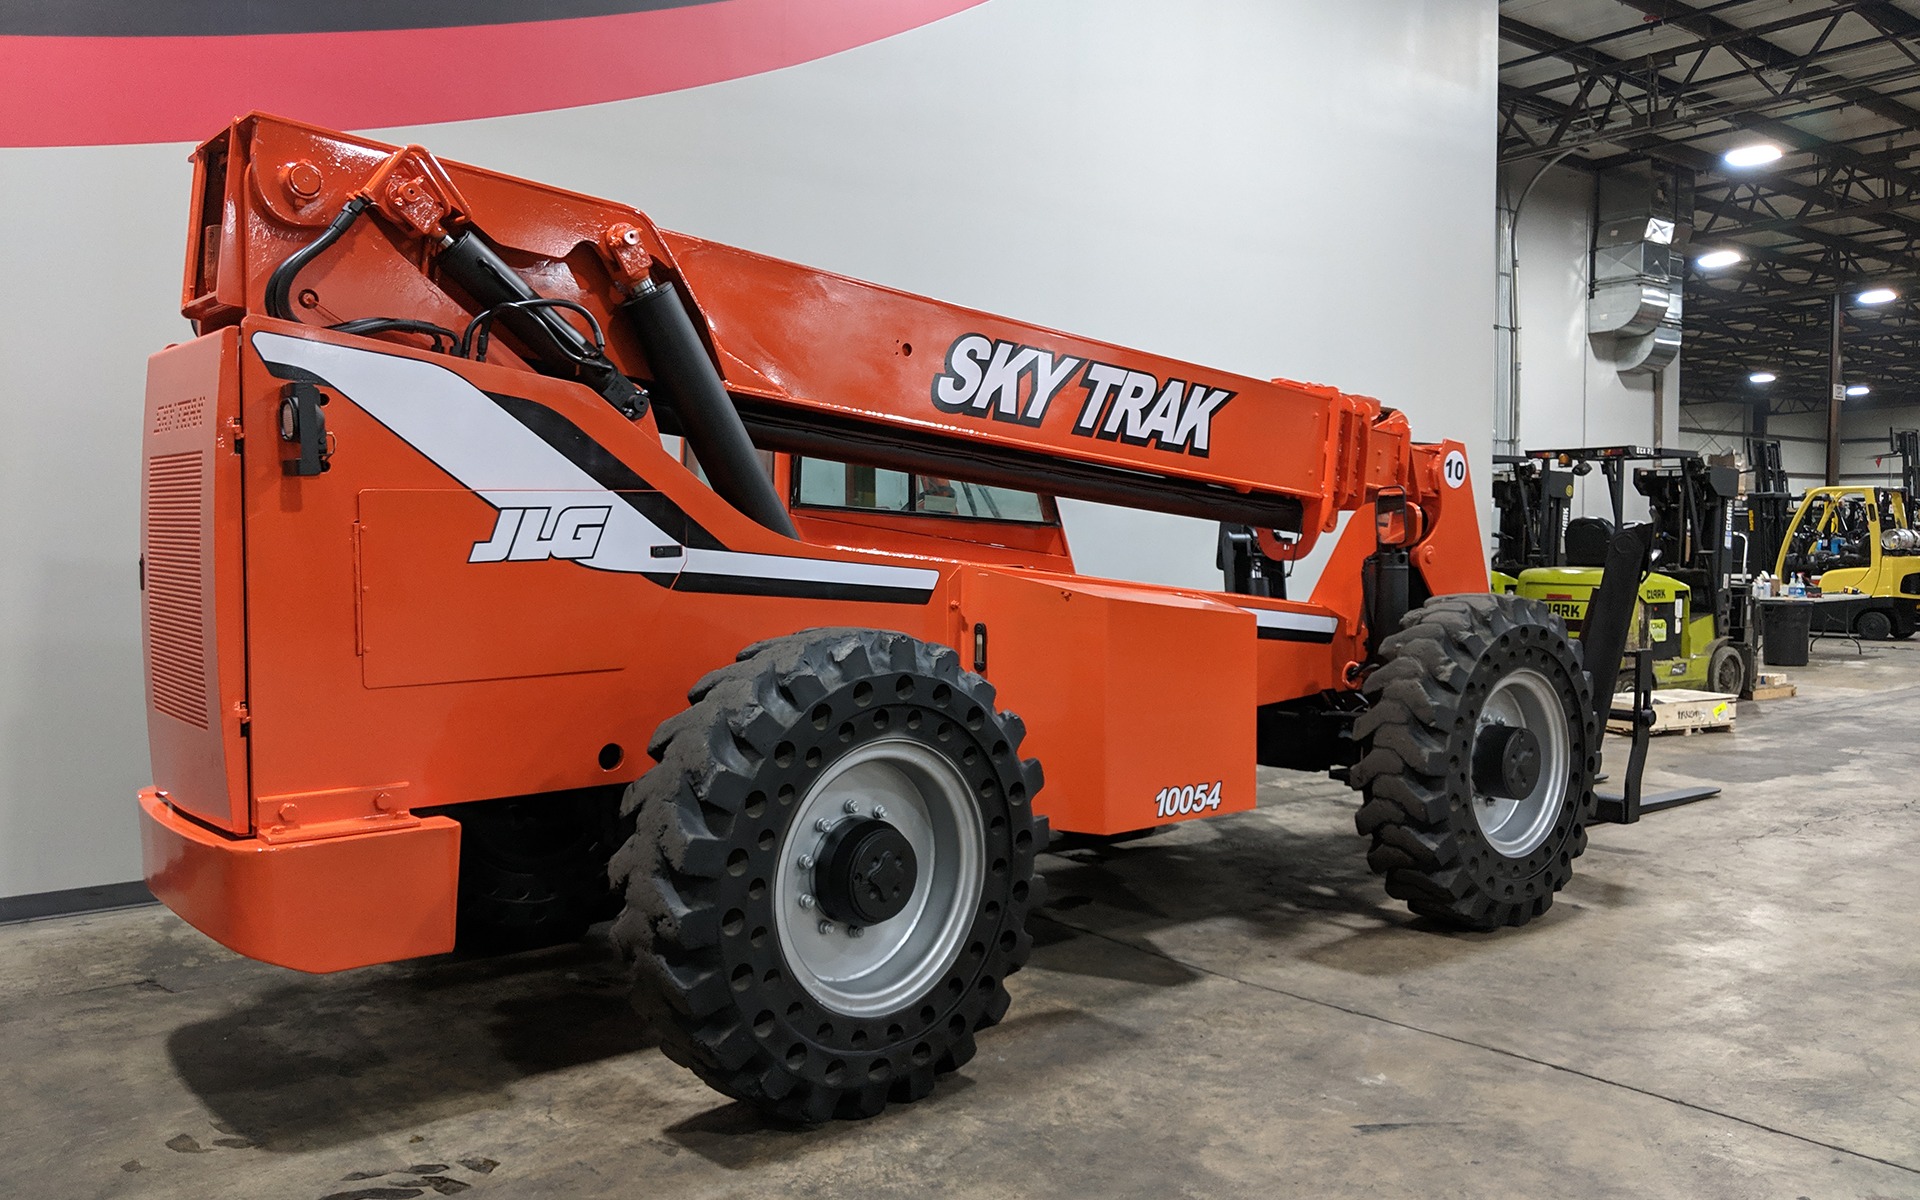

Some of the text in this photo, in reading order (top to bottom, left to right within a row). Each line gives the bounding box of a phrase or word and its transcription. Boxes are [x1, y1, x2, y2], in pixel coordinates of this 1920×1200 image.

[932, 334, 1236, 458] SKY TRAK
[1446, 459, 1464, 480] 10
[1725, 499, 1733, 531] CLARK
[466, 506, 613, 563] JLG
[1646, 589, 1666, 600] CLARK
[1154, 781, 1223, 818] 10054
